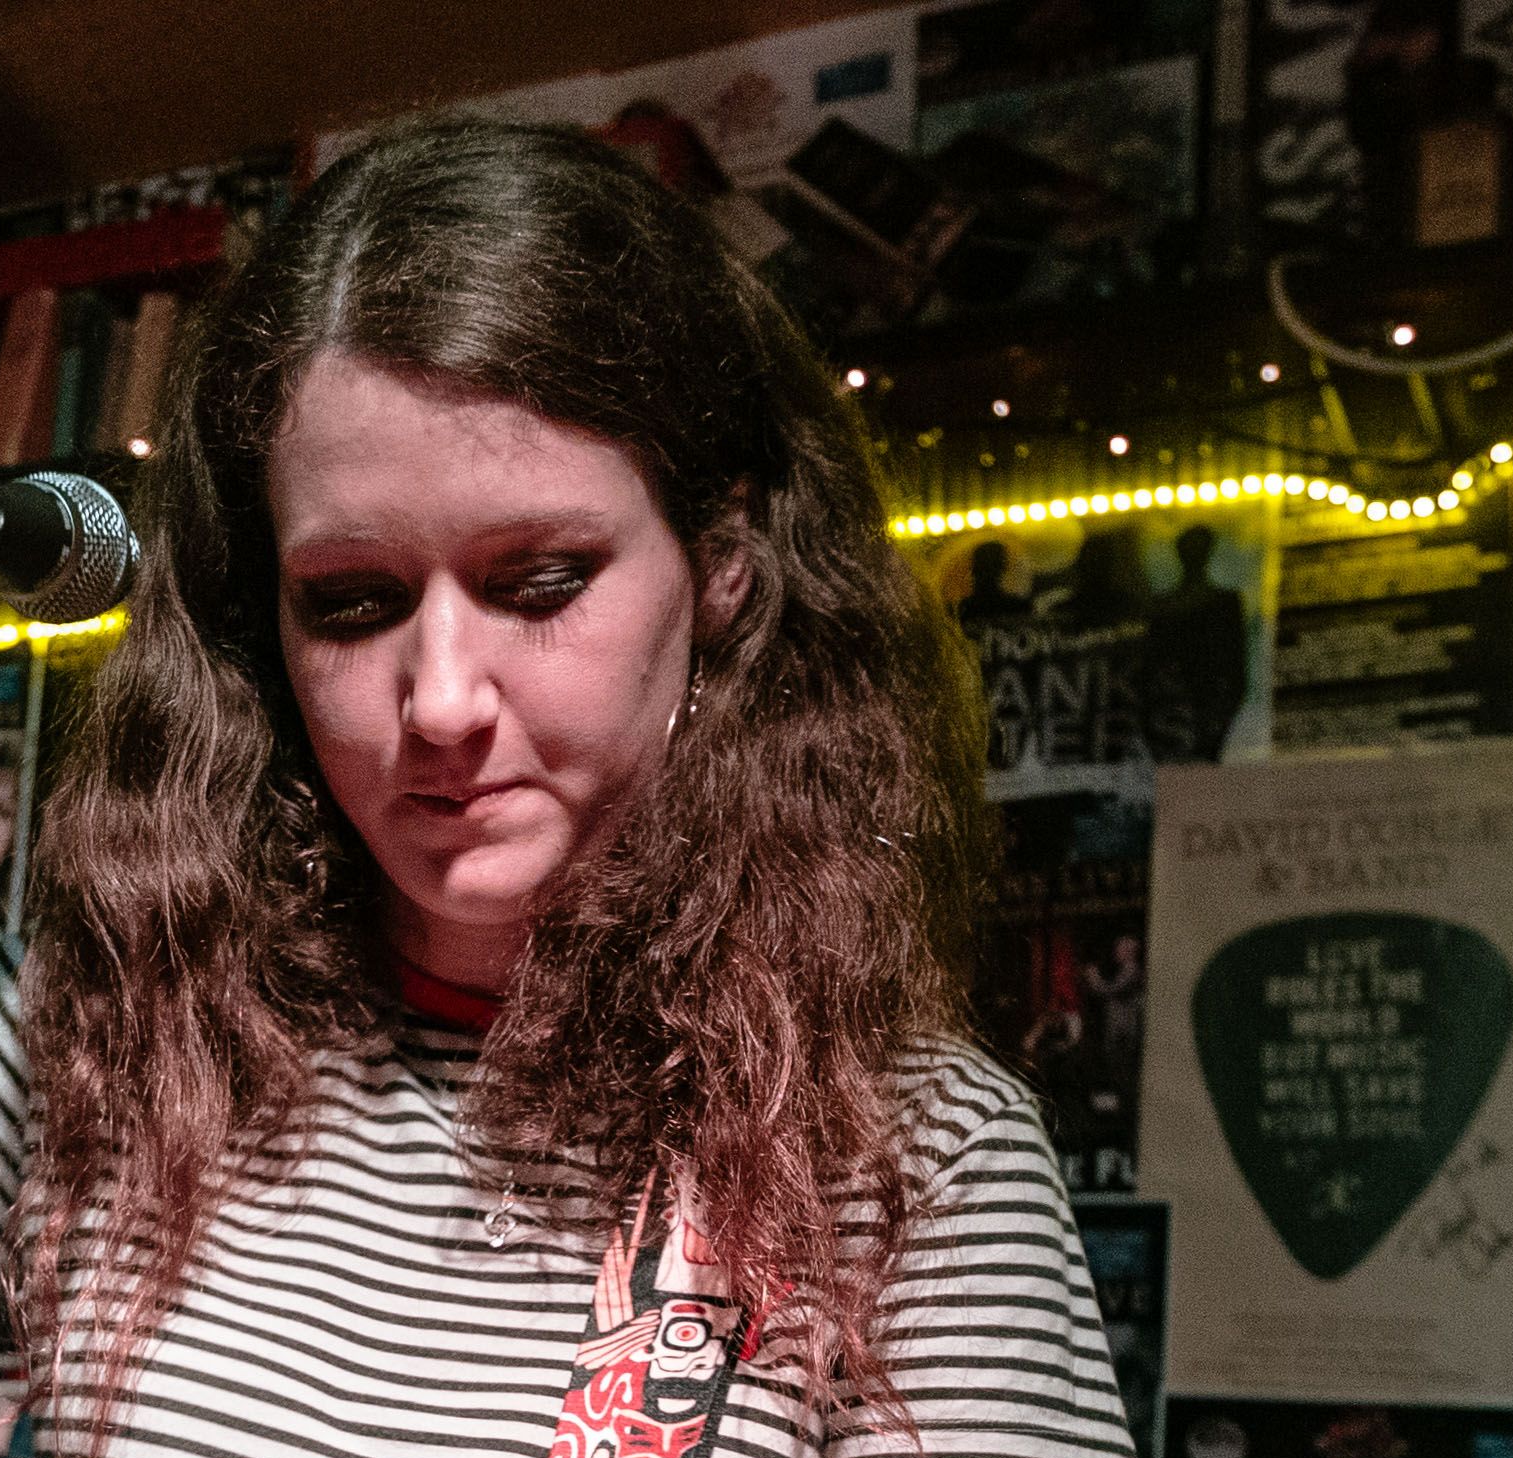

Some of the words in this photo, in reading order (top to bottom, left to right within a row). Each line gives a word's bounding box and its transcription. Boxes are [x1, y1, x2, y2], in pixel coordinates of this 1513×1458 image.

[1179, 813, 1330, 860] DAVID
[1304, 852, 1450, 895] BAND
[1366, 969, 1426, 1004] THE
